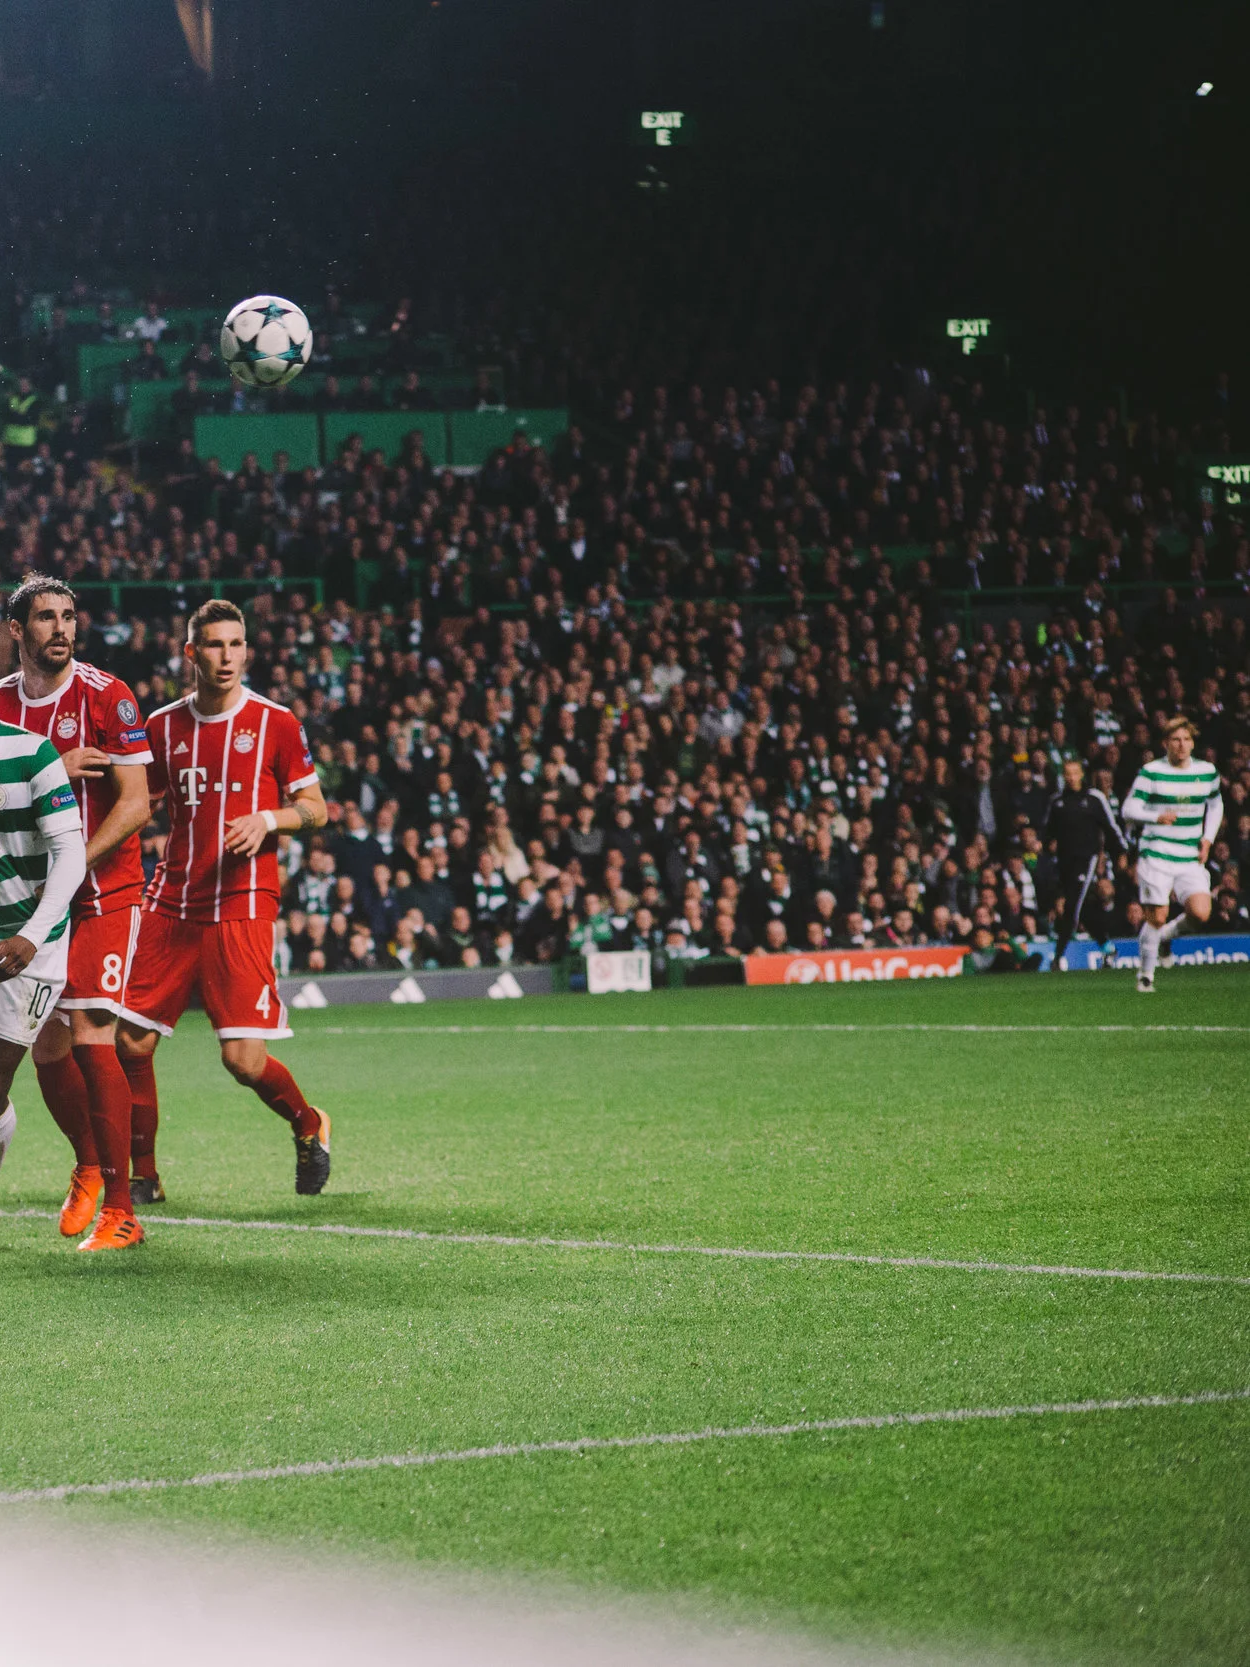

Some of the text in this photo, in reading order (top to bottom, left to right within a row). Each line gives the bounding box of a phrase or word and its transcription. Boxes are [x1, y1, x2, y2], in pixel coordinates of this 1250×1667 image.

[641, 112, 684, 128] EXIT
[656, 129, 672, 145] E
[947, 319, 991, 336] EXIT
[963, 337, 977, 354] F
[1208, 465, 1250, 484] EXIT
[101, 953, 122, 992] 8
[28, 982, 52, 1019] 10
[255, 984, 271, 1019] 4
